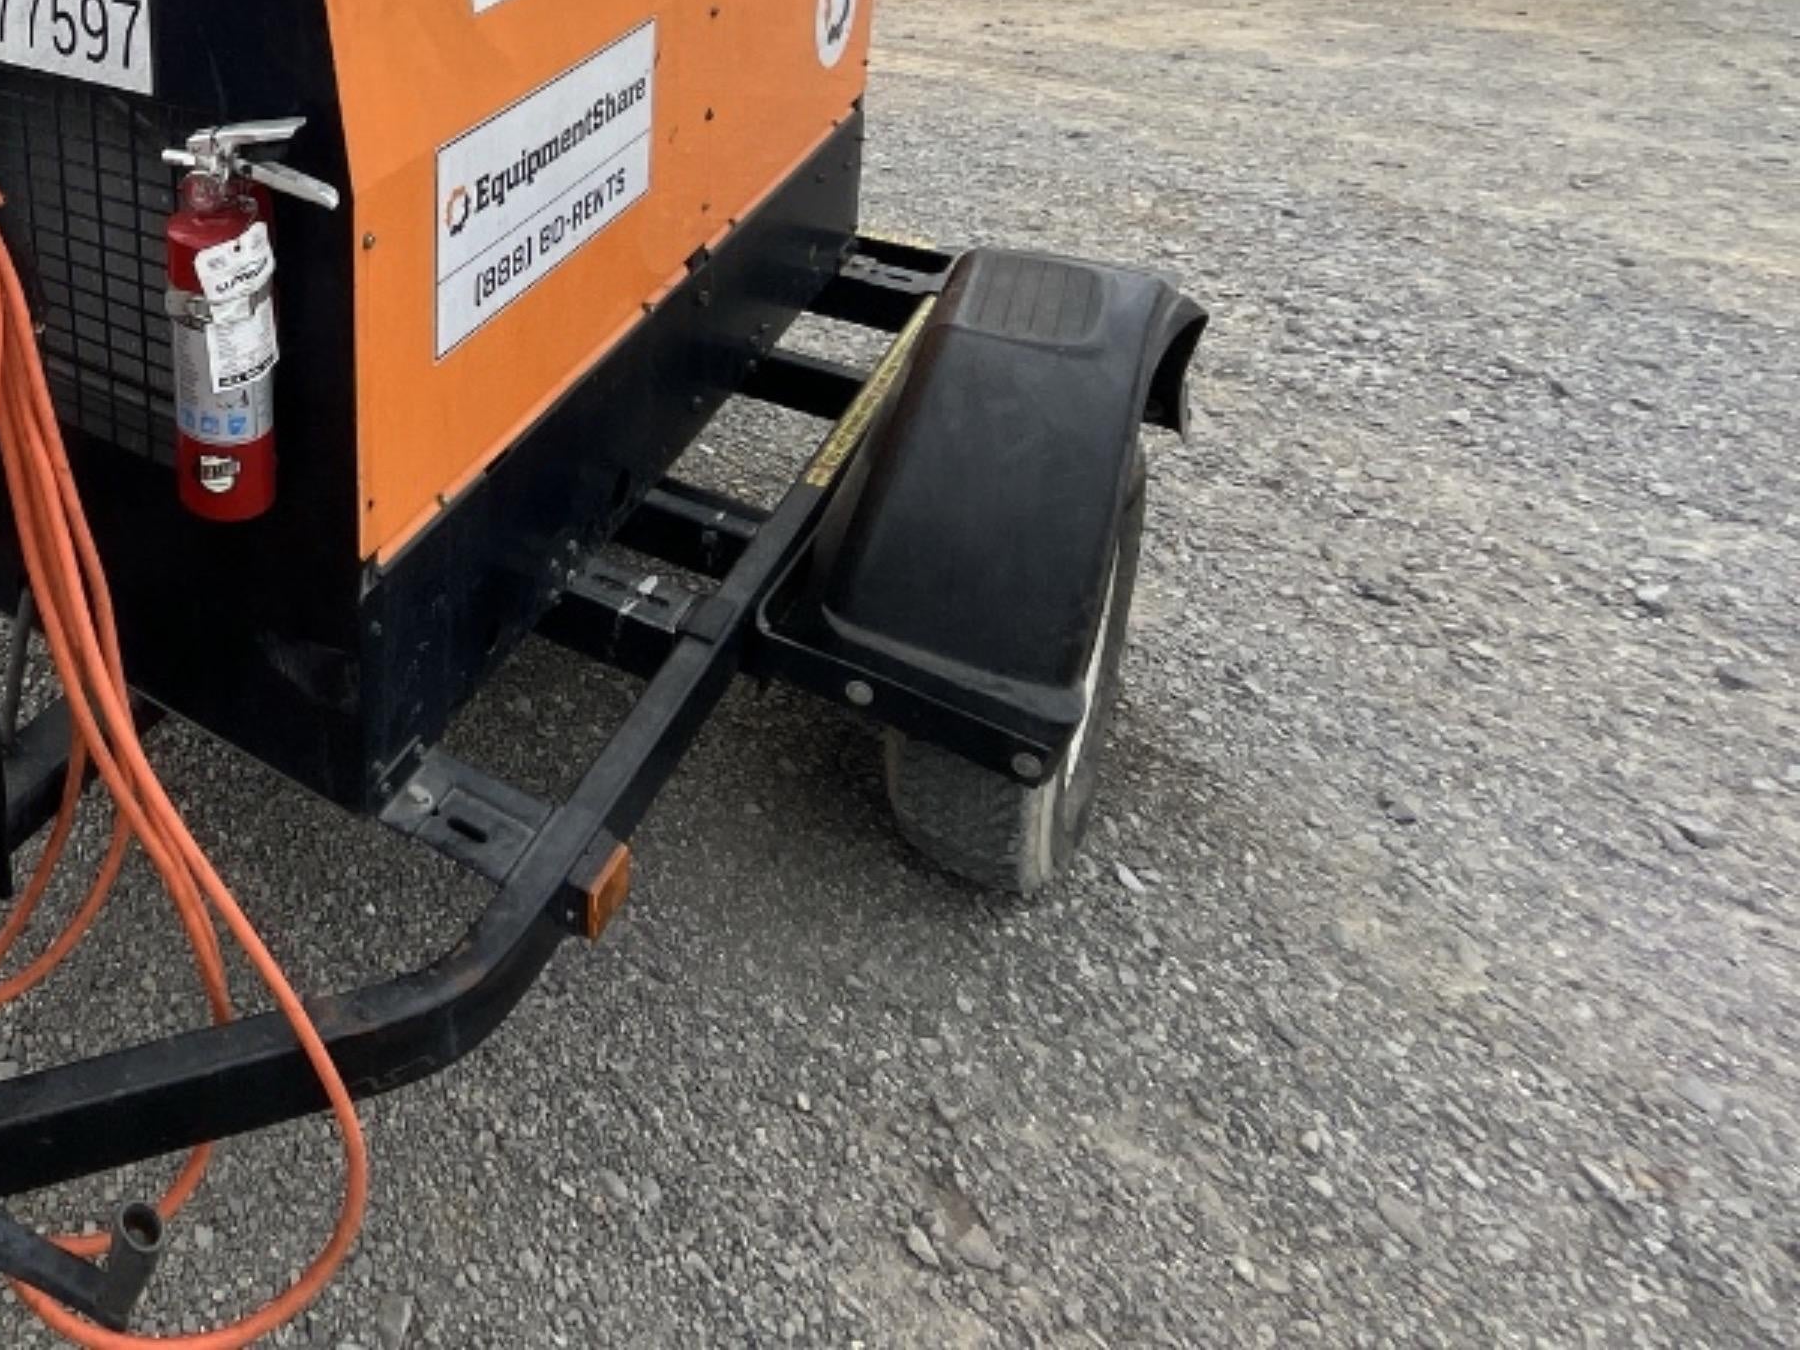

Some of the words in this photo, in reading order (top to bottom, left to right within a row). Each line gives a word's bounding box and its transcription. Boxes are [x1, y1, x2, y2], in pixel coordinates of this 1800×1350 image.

[473, 76, 647, 213] EquipmentShare
[473, 235, 533, 308] (888)
[539, 167, 626, 256] 80-RENTS
